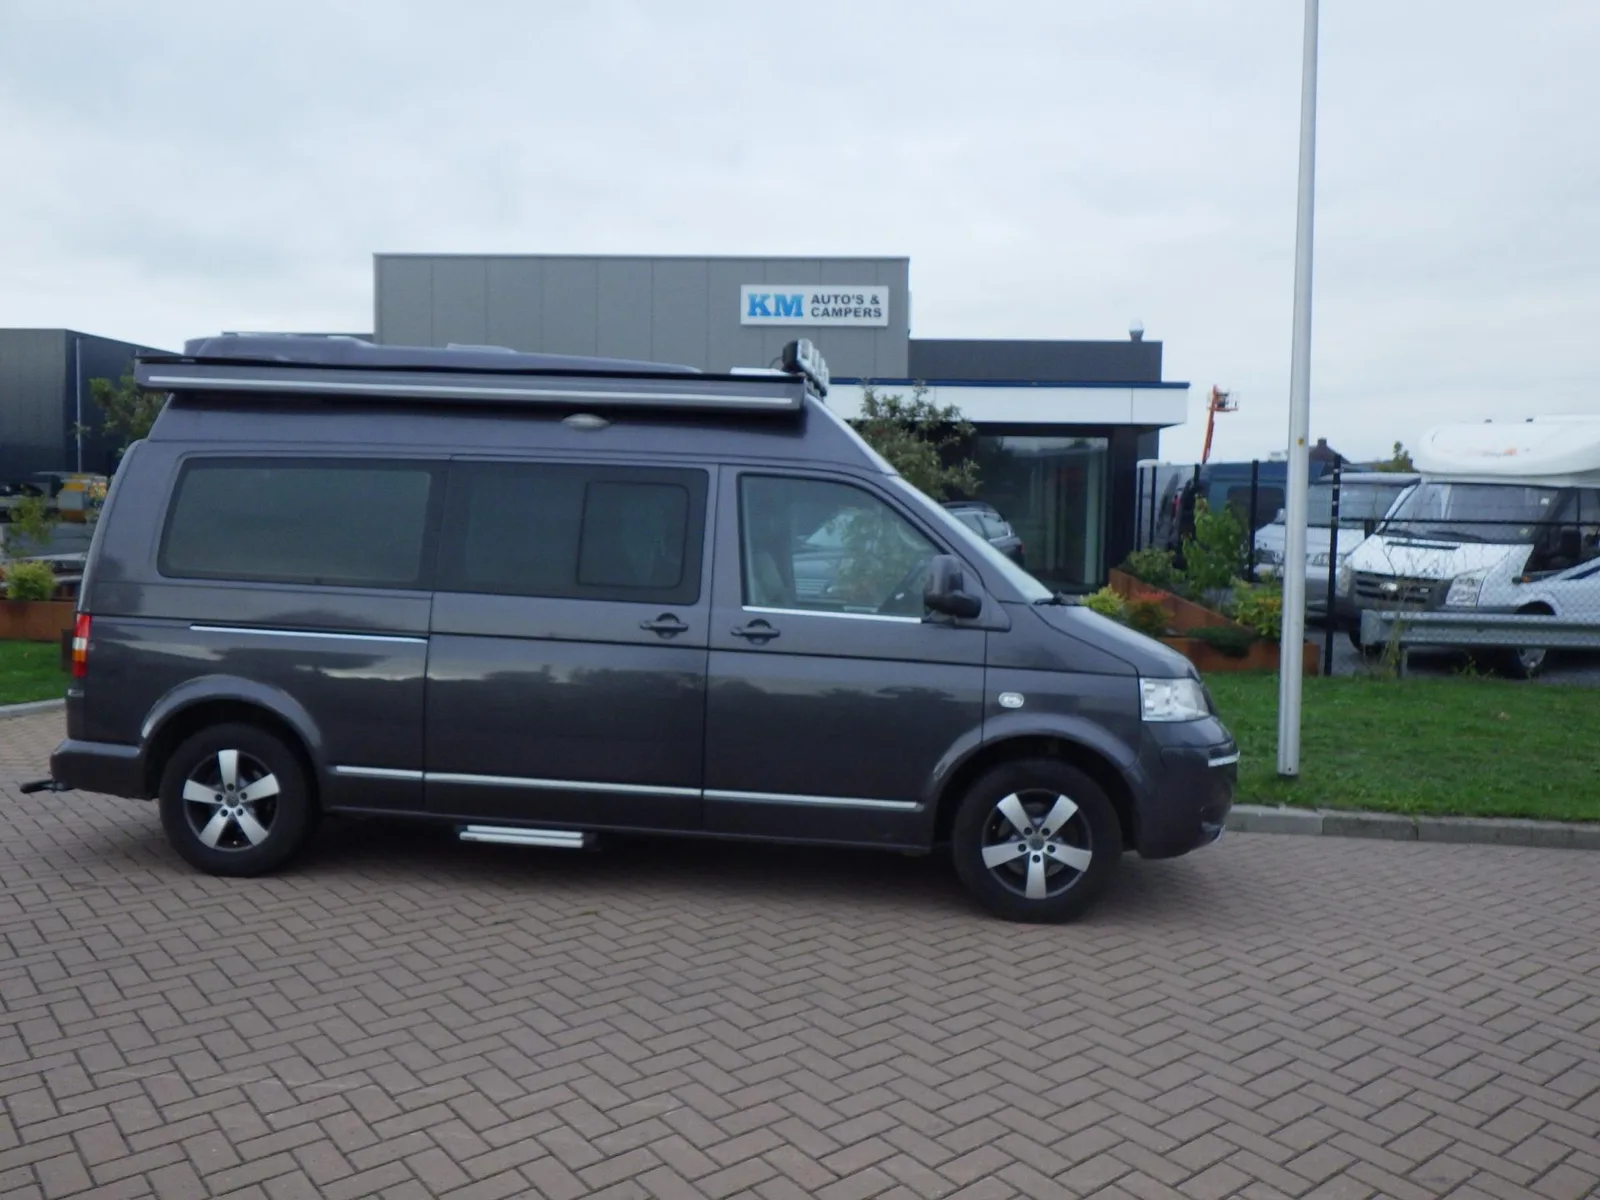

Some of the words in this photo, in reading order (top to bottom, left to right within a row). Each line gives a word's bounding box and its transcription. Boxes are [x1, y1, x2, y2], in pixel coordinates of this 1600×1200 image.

[748, 293, 804, 317] KM
[811, 294, 864, 305] AUTO'S
[870, 294, 880, 305] &
[811, 306, 882, 318] CAMPERS
